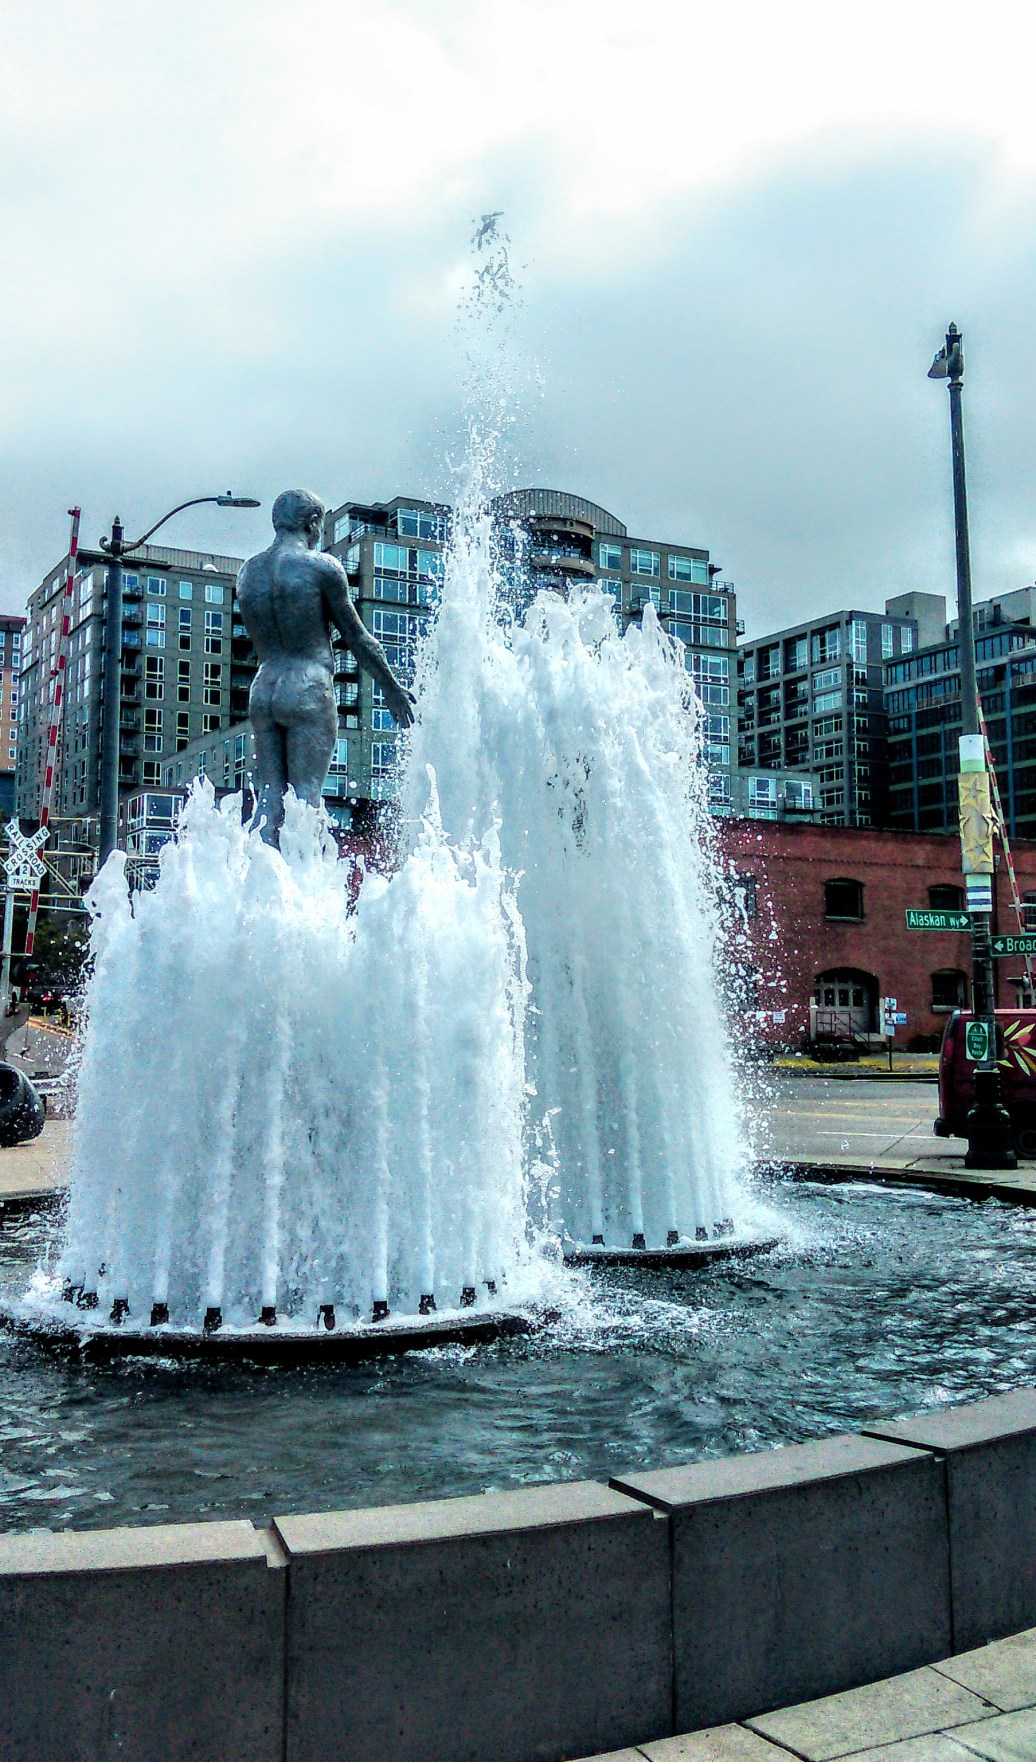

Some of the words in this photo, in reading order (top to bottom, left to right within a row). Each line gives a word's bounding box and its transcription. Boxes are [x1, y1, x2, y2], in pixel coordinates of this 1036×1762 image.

[5, 828, 48, 872] CROSSING
[22, 865, 28, 875] 2
[13, 878, 36, 886] TRACKS
[909, 911, 946, 926] Alaskan
[949, 917, 960, 929] Wy
